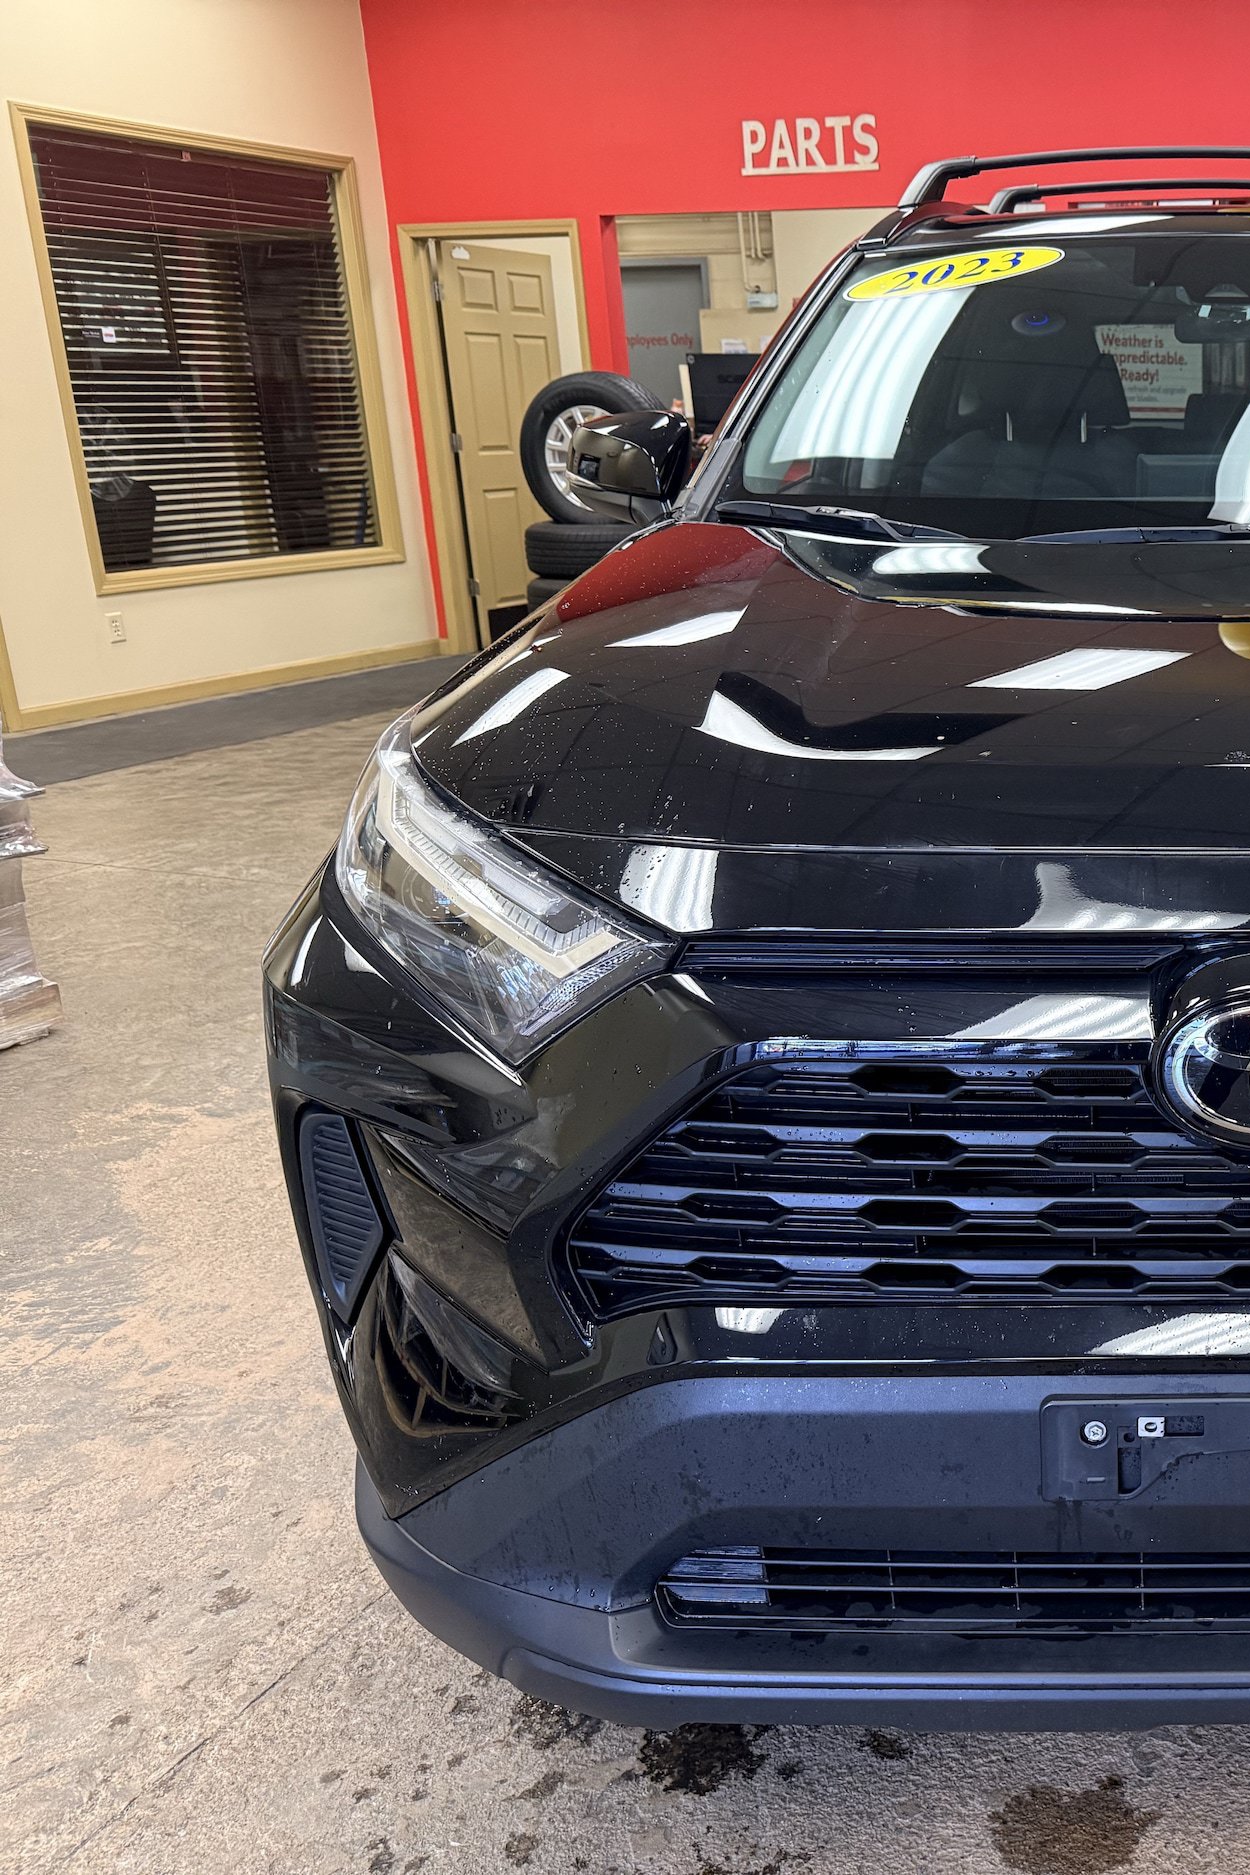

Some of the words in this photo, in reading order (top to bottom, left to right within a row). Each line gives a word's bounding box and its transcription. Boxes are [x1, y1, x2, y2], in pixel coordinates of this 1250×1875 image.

[741, 114, 879, 173] PARTS
[885, 252, 1025, 293] 2023
[626, 333, 669, 349] ployees
[671, 332, 693, 349] Only
[1101, 332, 1152, 348] Weather
[1154, 335, 1164, 349] is
[1102, 350, 1188, 366] predictable.
[1120, 368, 1159, 385] Ready!
